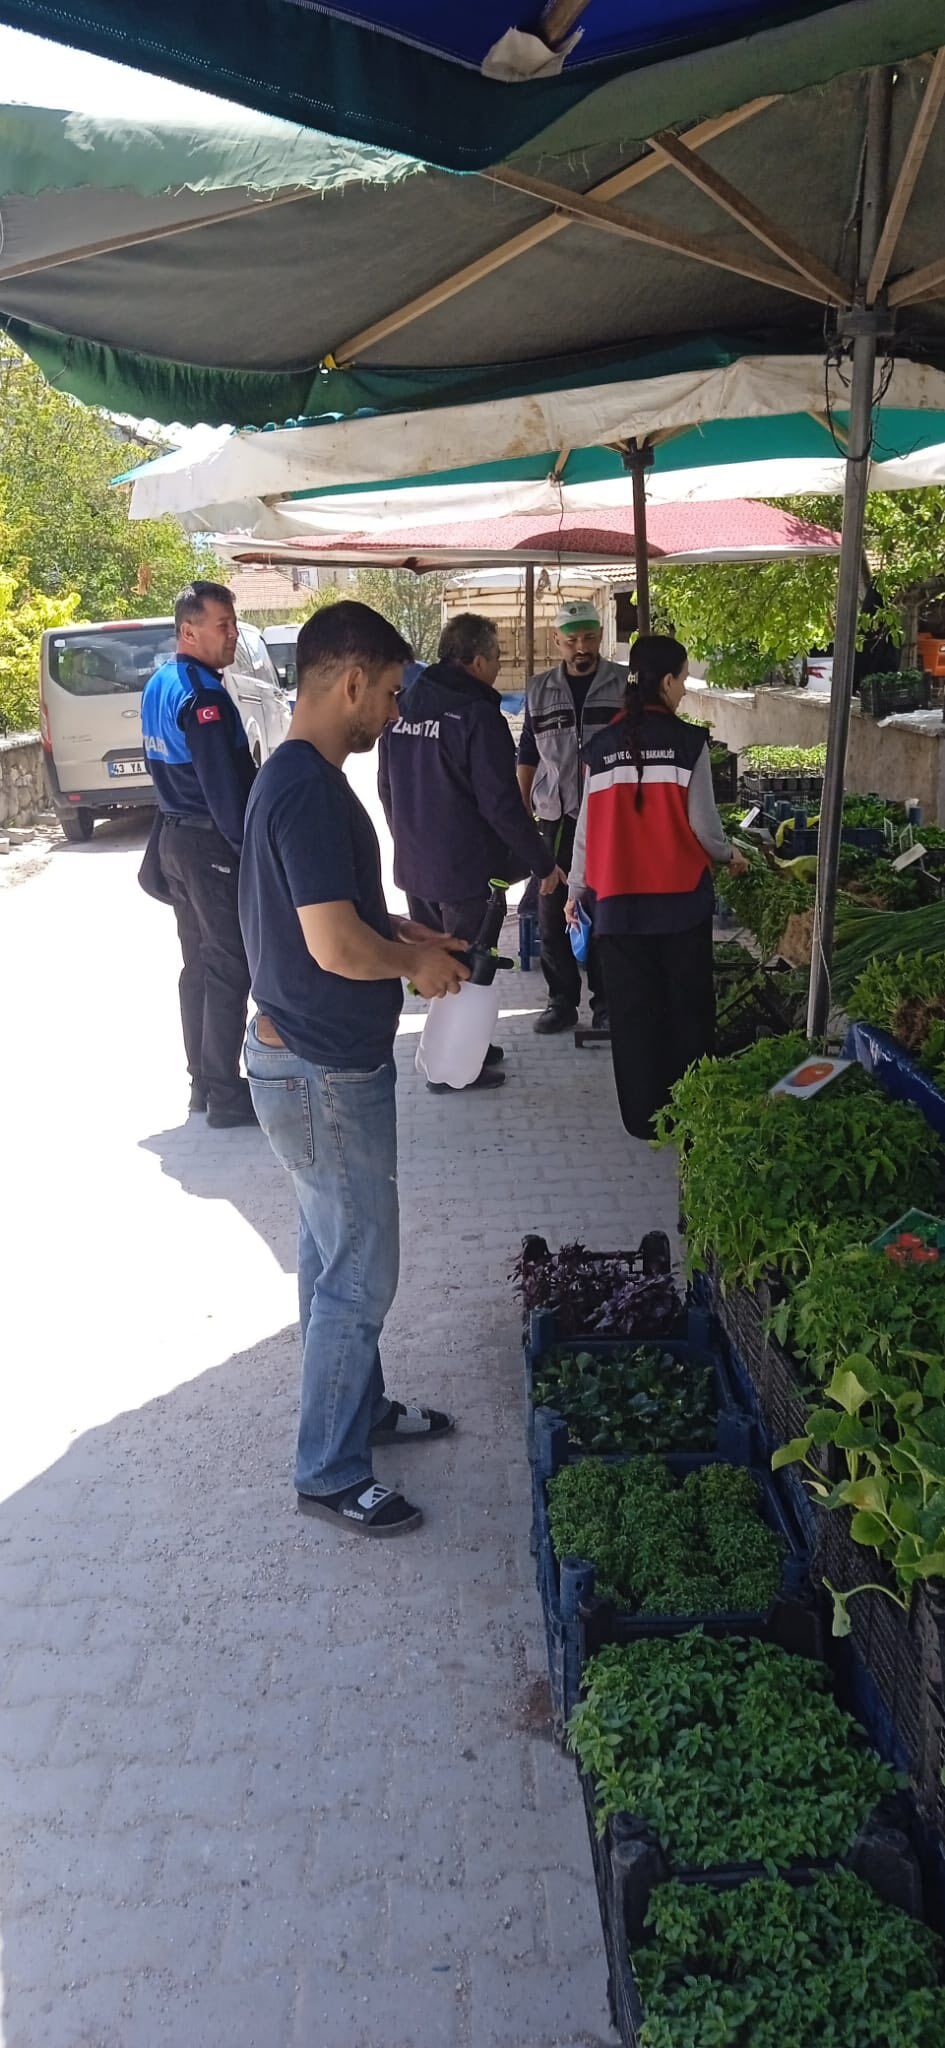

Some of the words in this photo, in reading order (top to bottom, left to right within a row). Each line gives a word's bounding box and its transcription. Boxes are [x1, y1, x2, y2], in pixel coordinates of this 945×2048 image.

[617, 751, 625, 760] VE
[112, 763, 125, 774] 43
[343, 1509, 364, 1521] adidas
